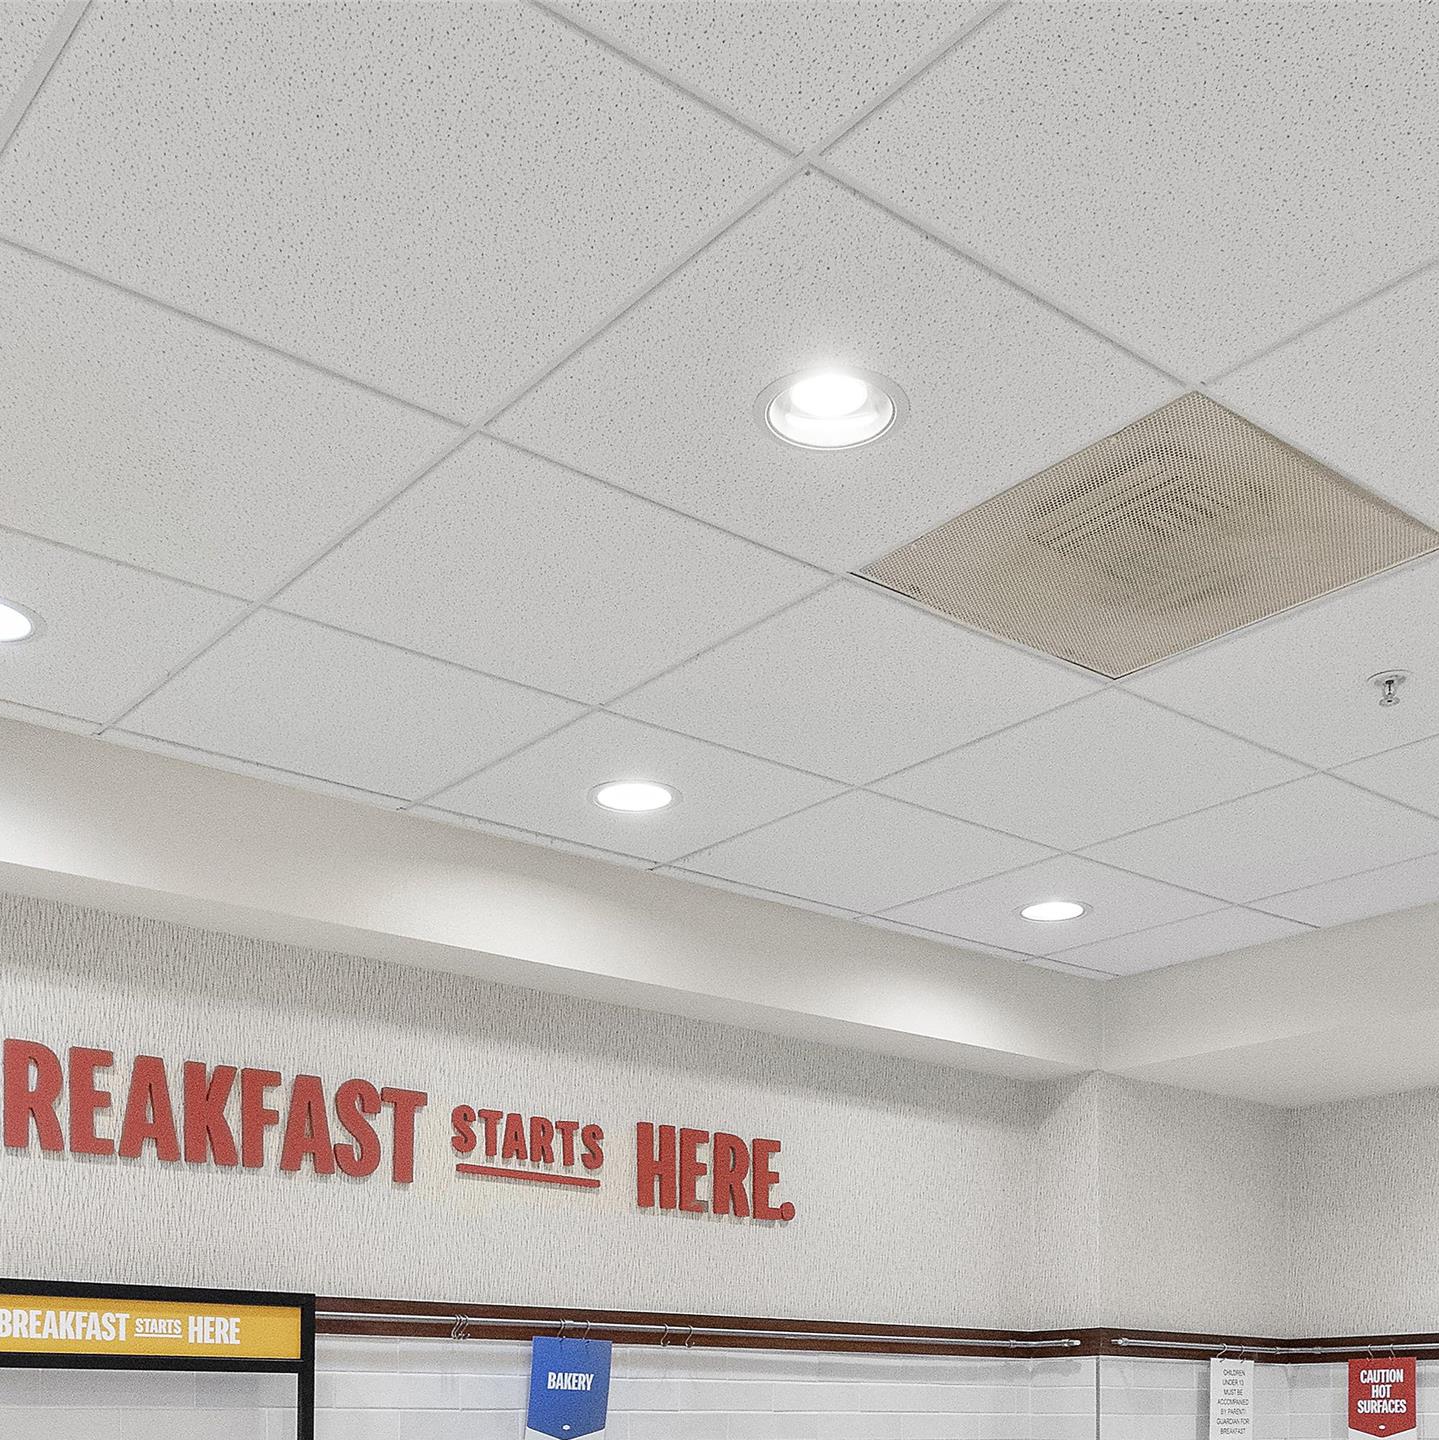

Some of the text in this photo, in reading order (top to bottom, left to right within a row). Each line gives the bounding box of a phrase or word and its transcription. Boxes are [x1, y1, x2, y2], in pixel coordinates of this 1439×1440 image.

[452, 1104, 605, 1171] STARTS
[637, 1122, 796, 1222] HERE.
[134, 1318, 183, 1335] STARTS
[188, 1315, 241, 1345] HERE
[547, 1371, 594, 1391] BAKERY
[1360, 1368, 1404, 1383] CAUTION
[1371, 1384, 1392, 1398] HOT
[1357, 1399, 1407, 1414] SURFACES
